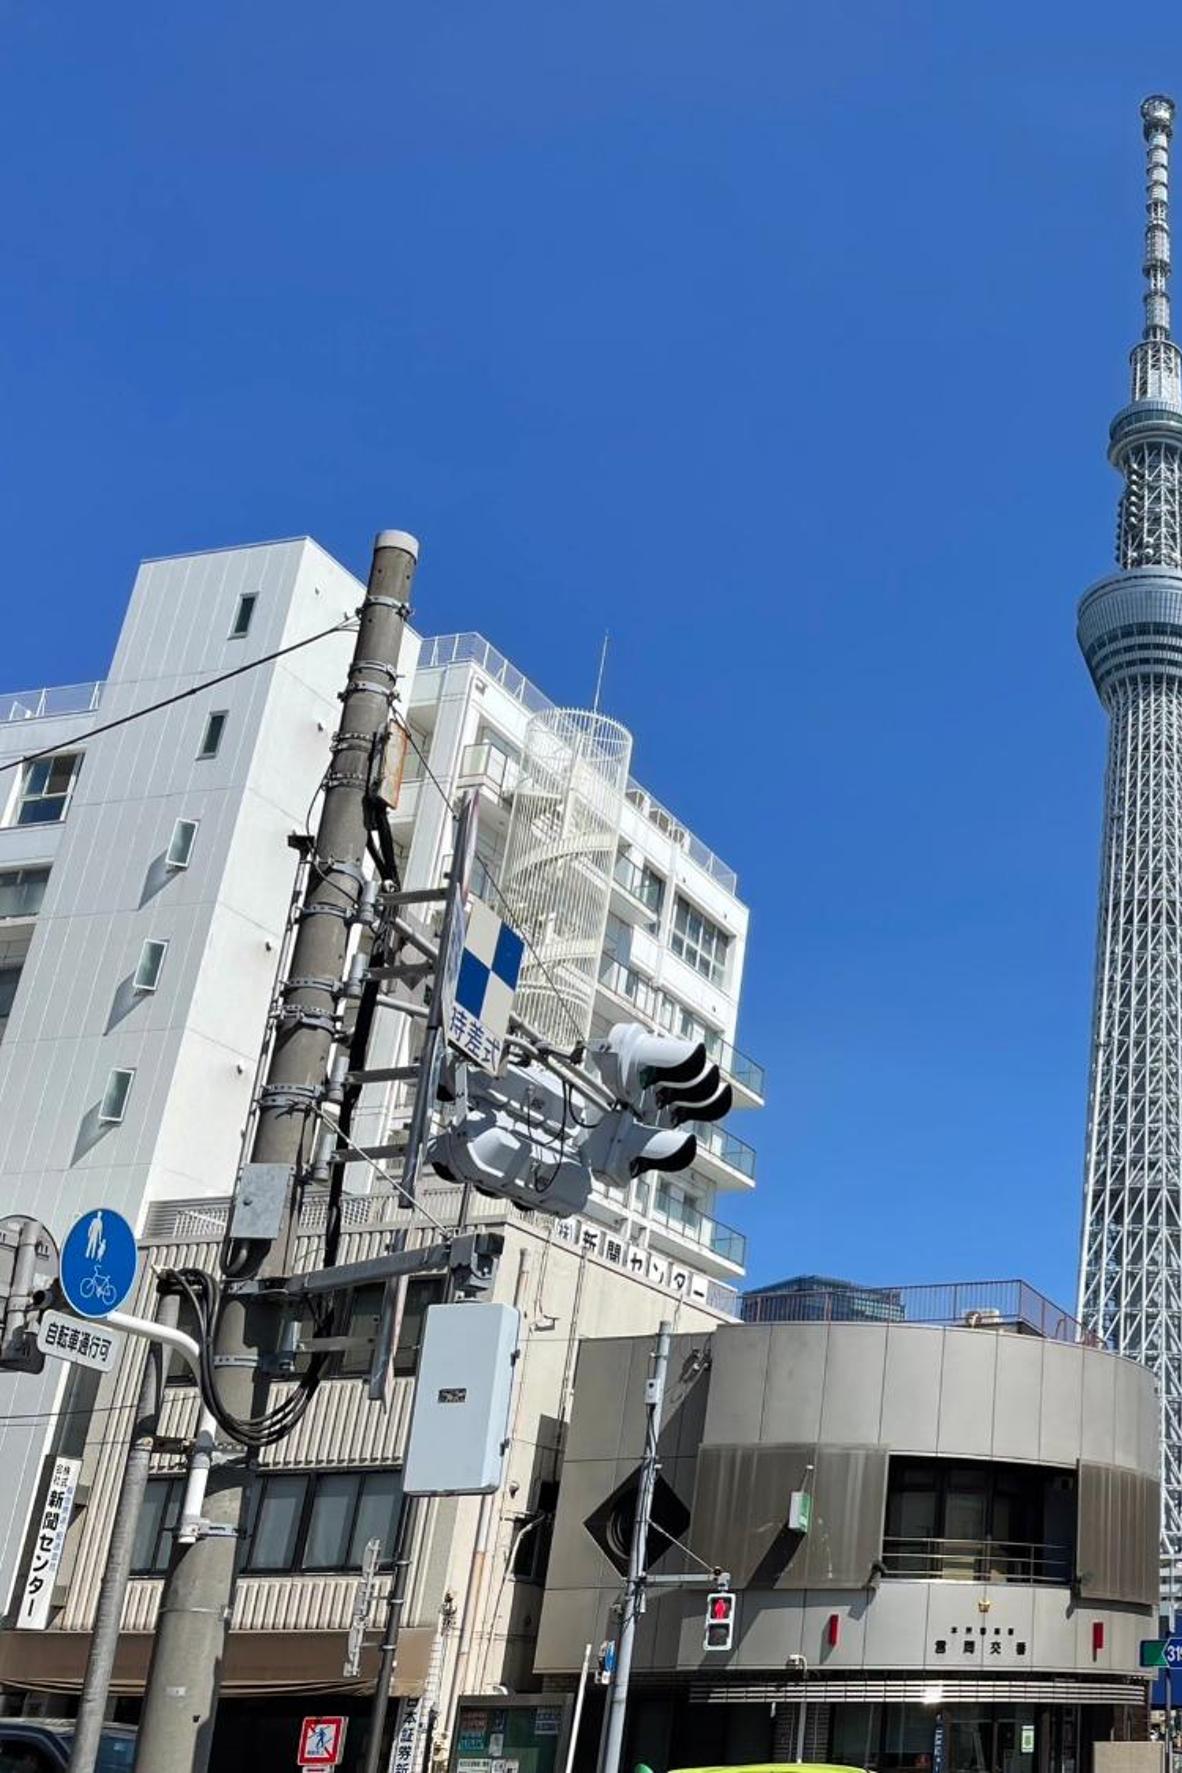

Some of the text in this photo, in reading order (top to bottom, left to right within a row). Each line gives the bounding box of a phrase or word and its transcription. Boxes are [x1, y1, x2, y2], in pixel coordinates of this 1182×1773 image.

[45, 1321, 112, 1362] 自転車通行可
[27, 1490, 65, 1617] 新聞センター
